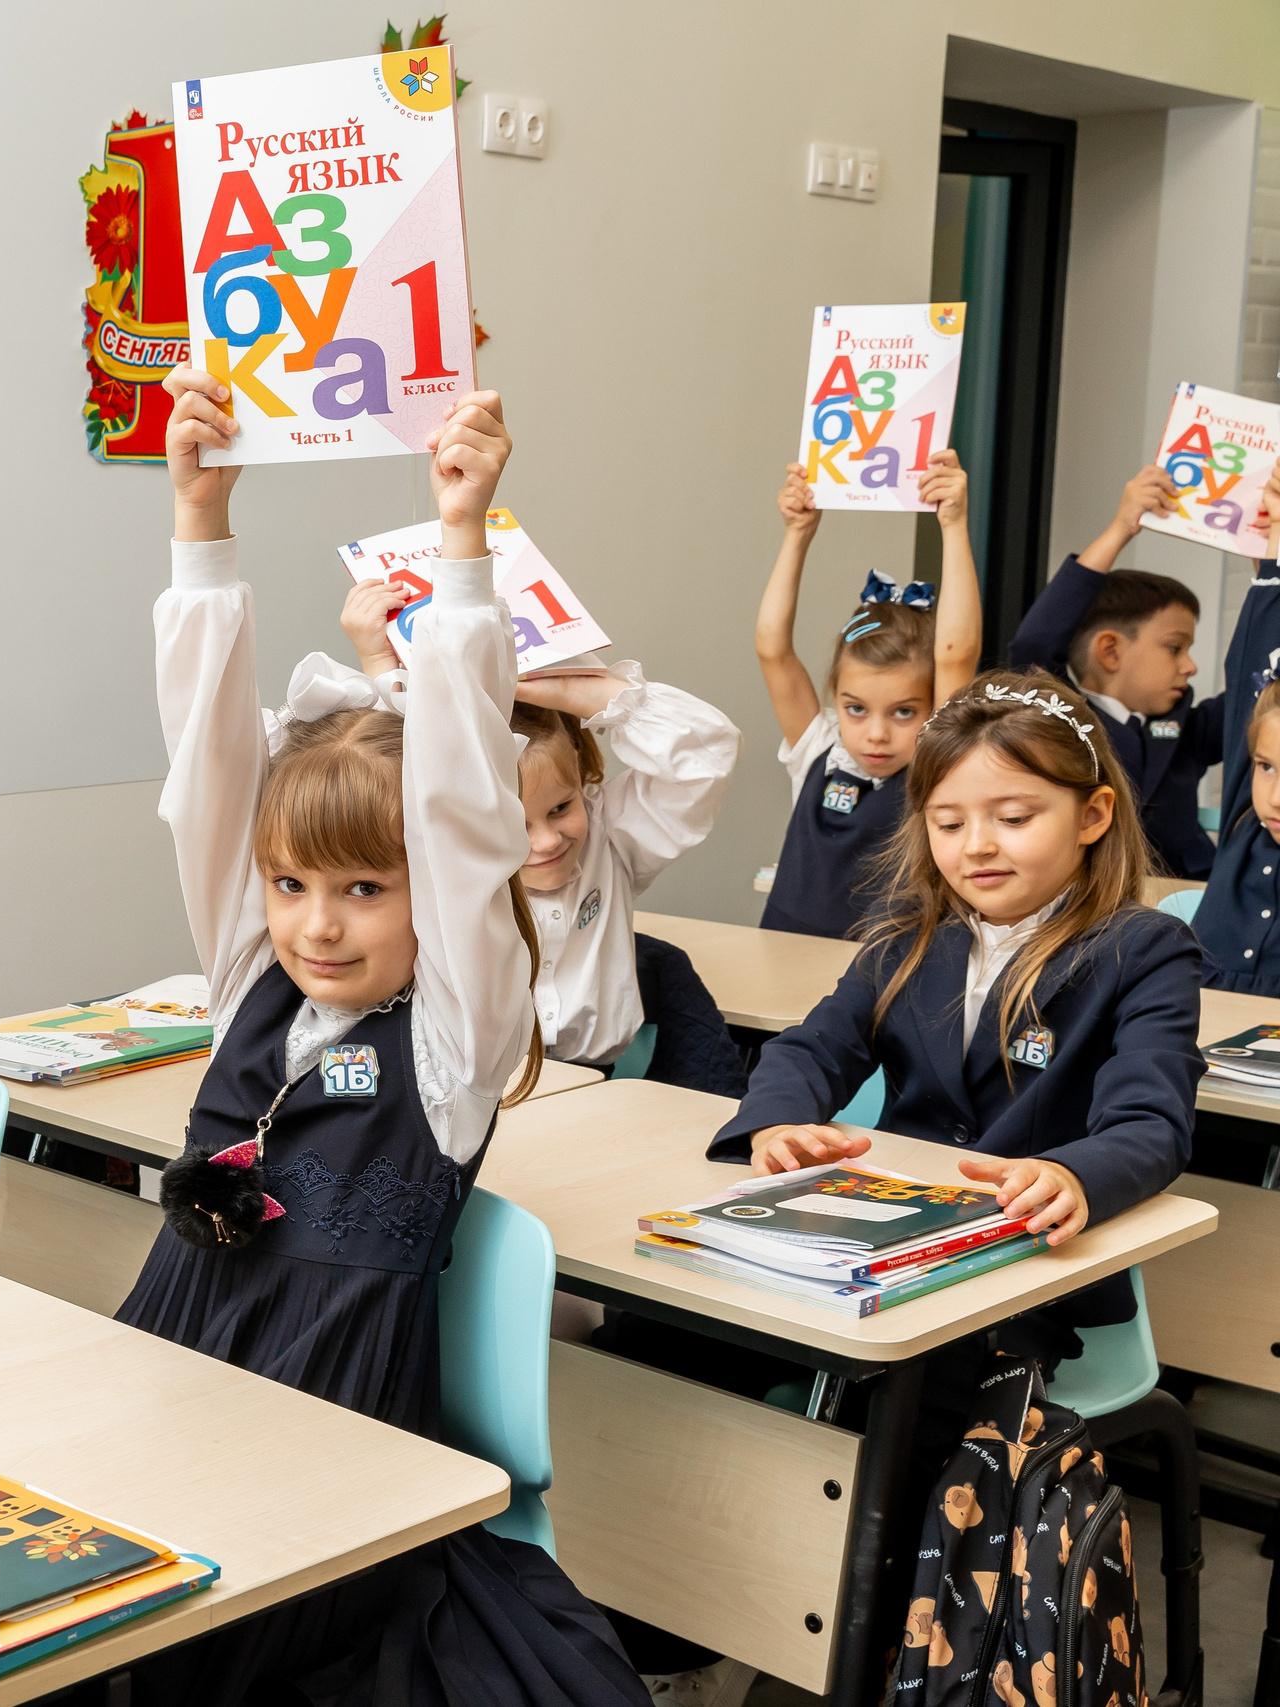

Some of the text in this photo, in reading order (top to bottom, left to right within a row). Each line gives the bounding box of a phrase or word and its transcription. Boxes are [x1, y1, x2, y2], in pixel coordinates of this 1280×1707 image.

[373, 67, 433, 122] ШКОЛА РОССИИ
[215, 116, 366, 168] Русский
[391, 260, 460, 382] 1
[102, 324, 191, 364] СЕНТЯБ
[835, 330, 915, 354] Русский
[403, 379, 456, 396] класс
[1195, 404, 1267, 436] Русский
[289, 429, 355, 446] Часть 1
[906, 411, 936, 471] 1
[376, 544, 443, 571] Русск
[520, 579, 582, 628] 1
[326, 1063, 373, 1091] 1Б
[887, 1255, 910, 1267] Русский
[961, 1440, 1000, 1472] CAPY BARA
